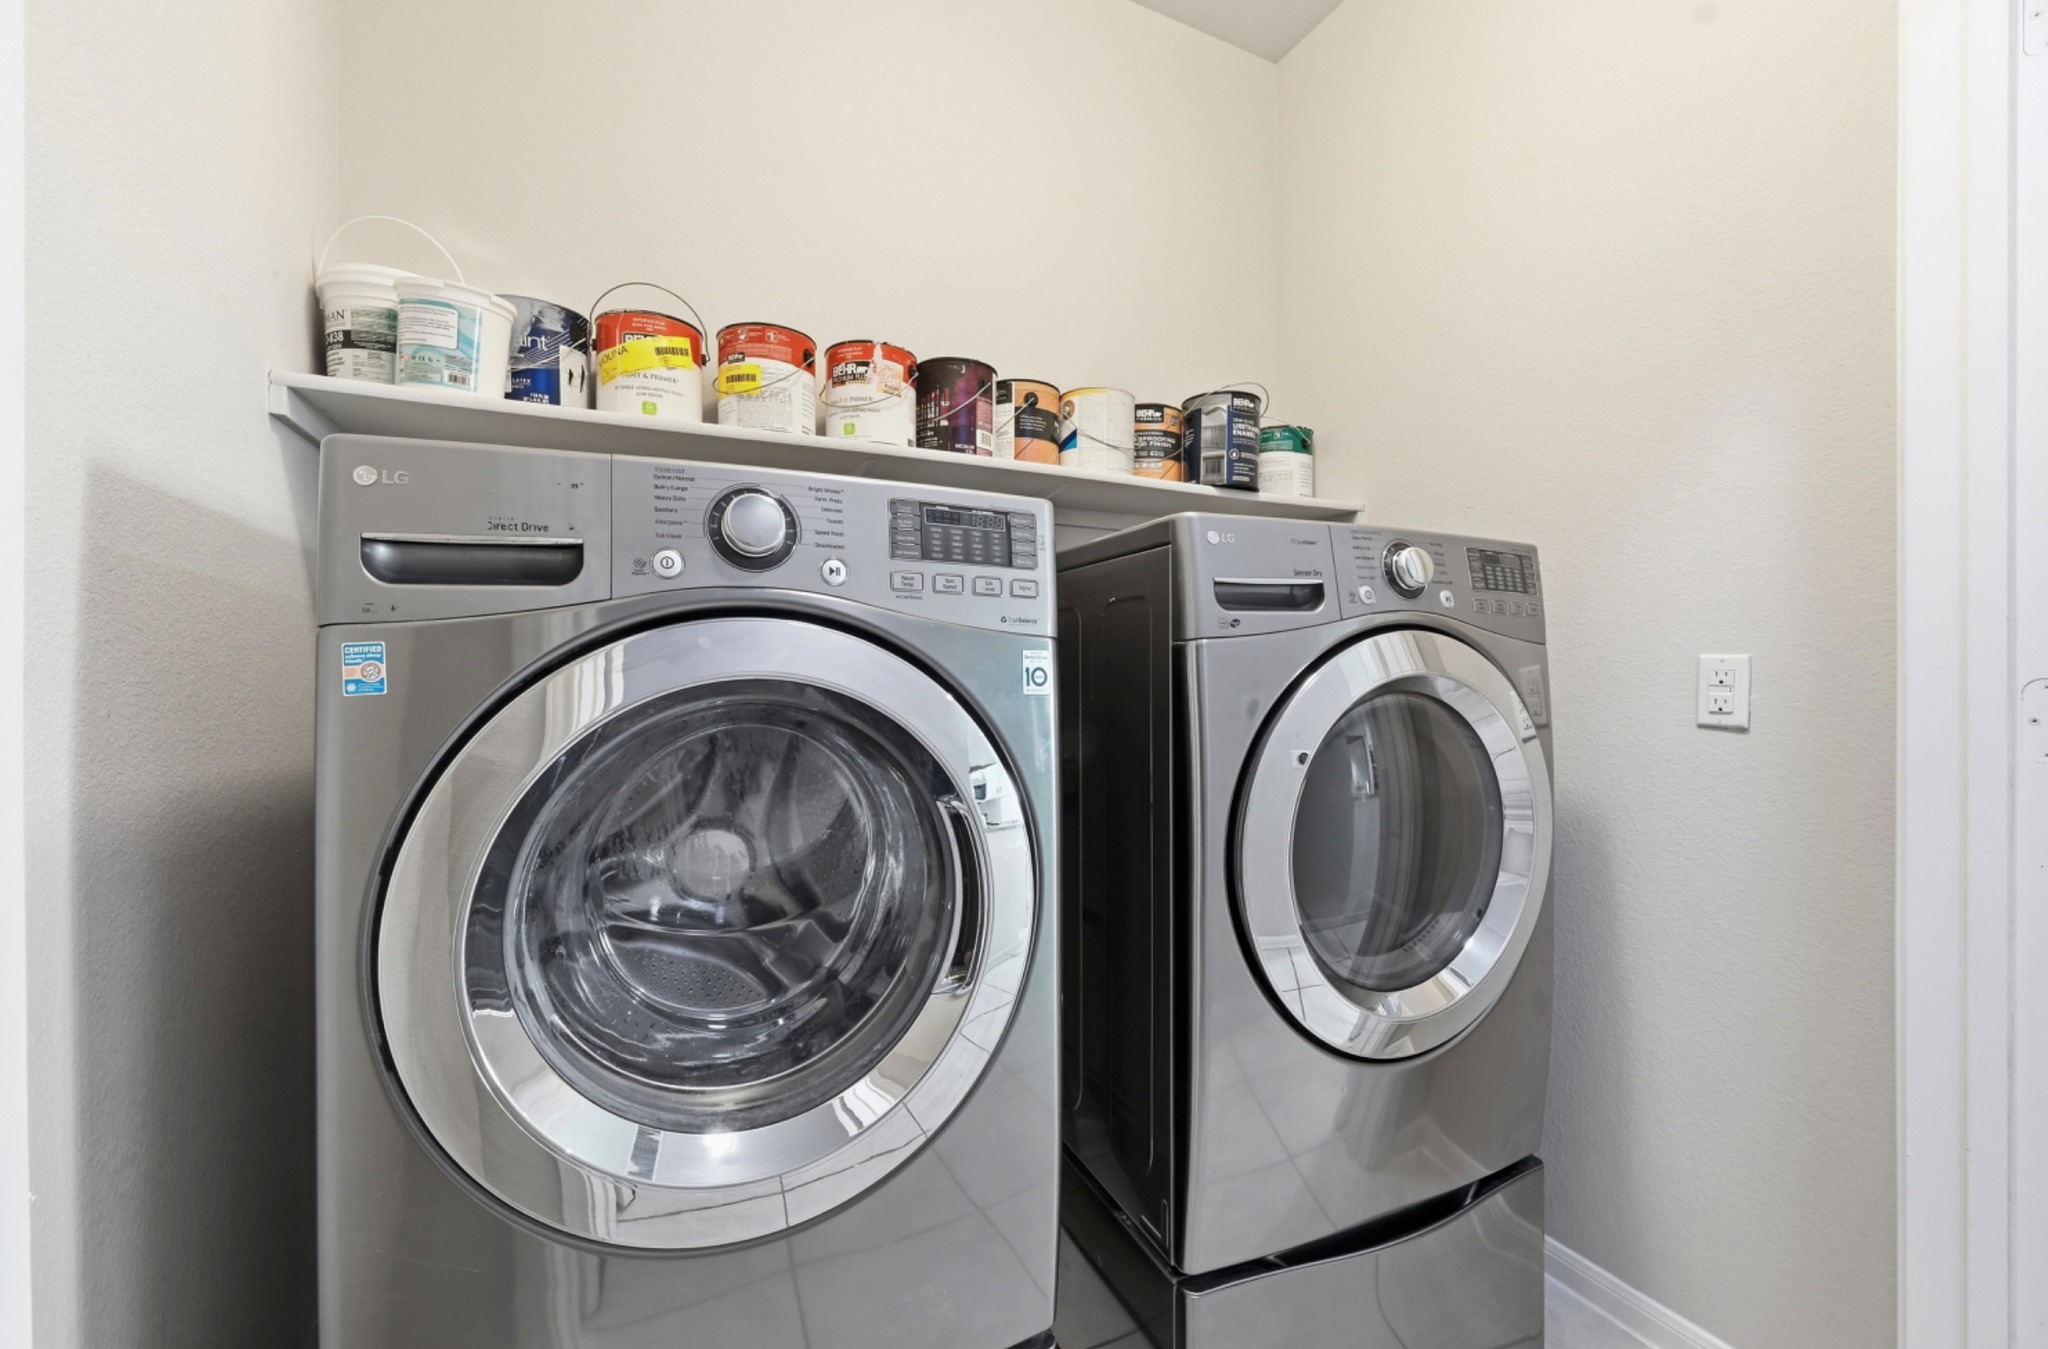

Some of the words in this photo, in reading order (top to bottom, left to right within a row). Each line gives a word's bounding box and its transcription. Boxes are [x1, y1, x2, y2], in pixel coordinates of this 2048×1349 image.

[833, 363, 857, 378] BEHR
[381, 470, 410, 485] LG
[521, 522, 549, 532] Drive
[1221, 533, 1235, 543] LG
[345, 645, 382, 653] CERTIFIED
[1025, 667, 1048, 687] 10
